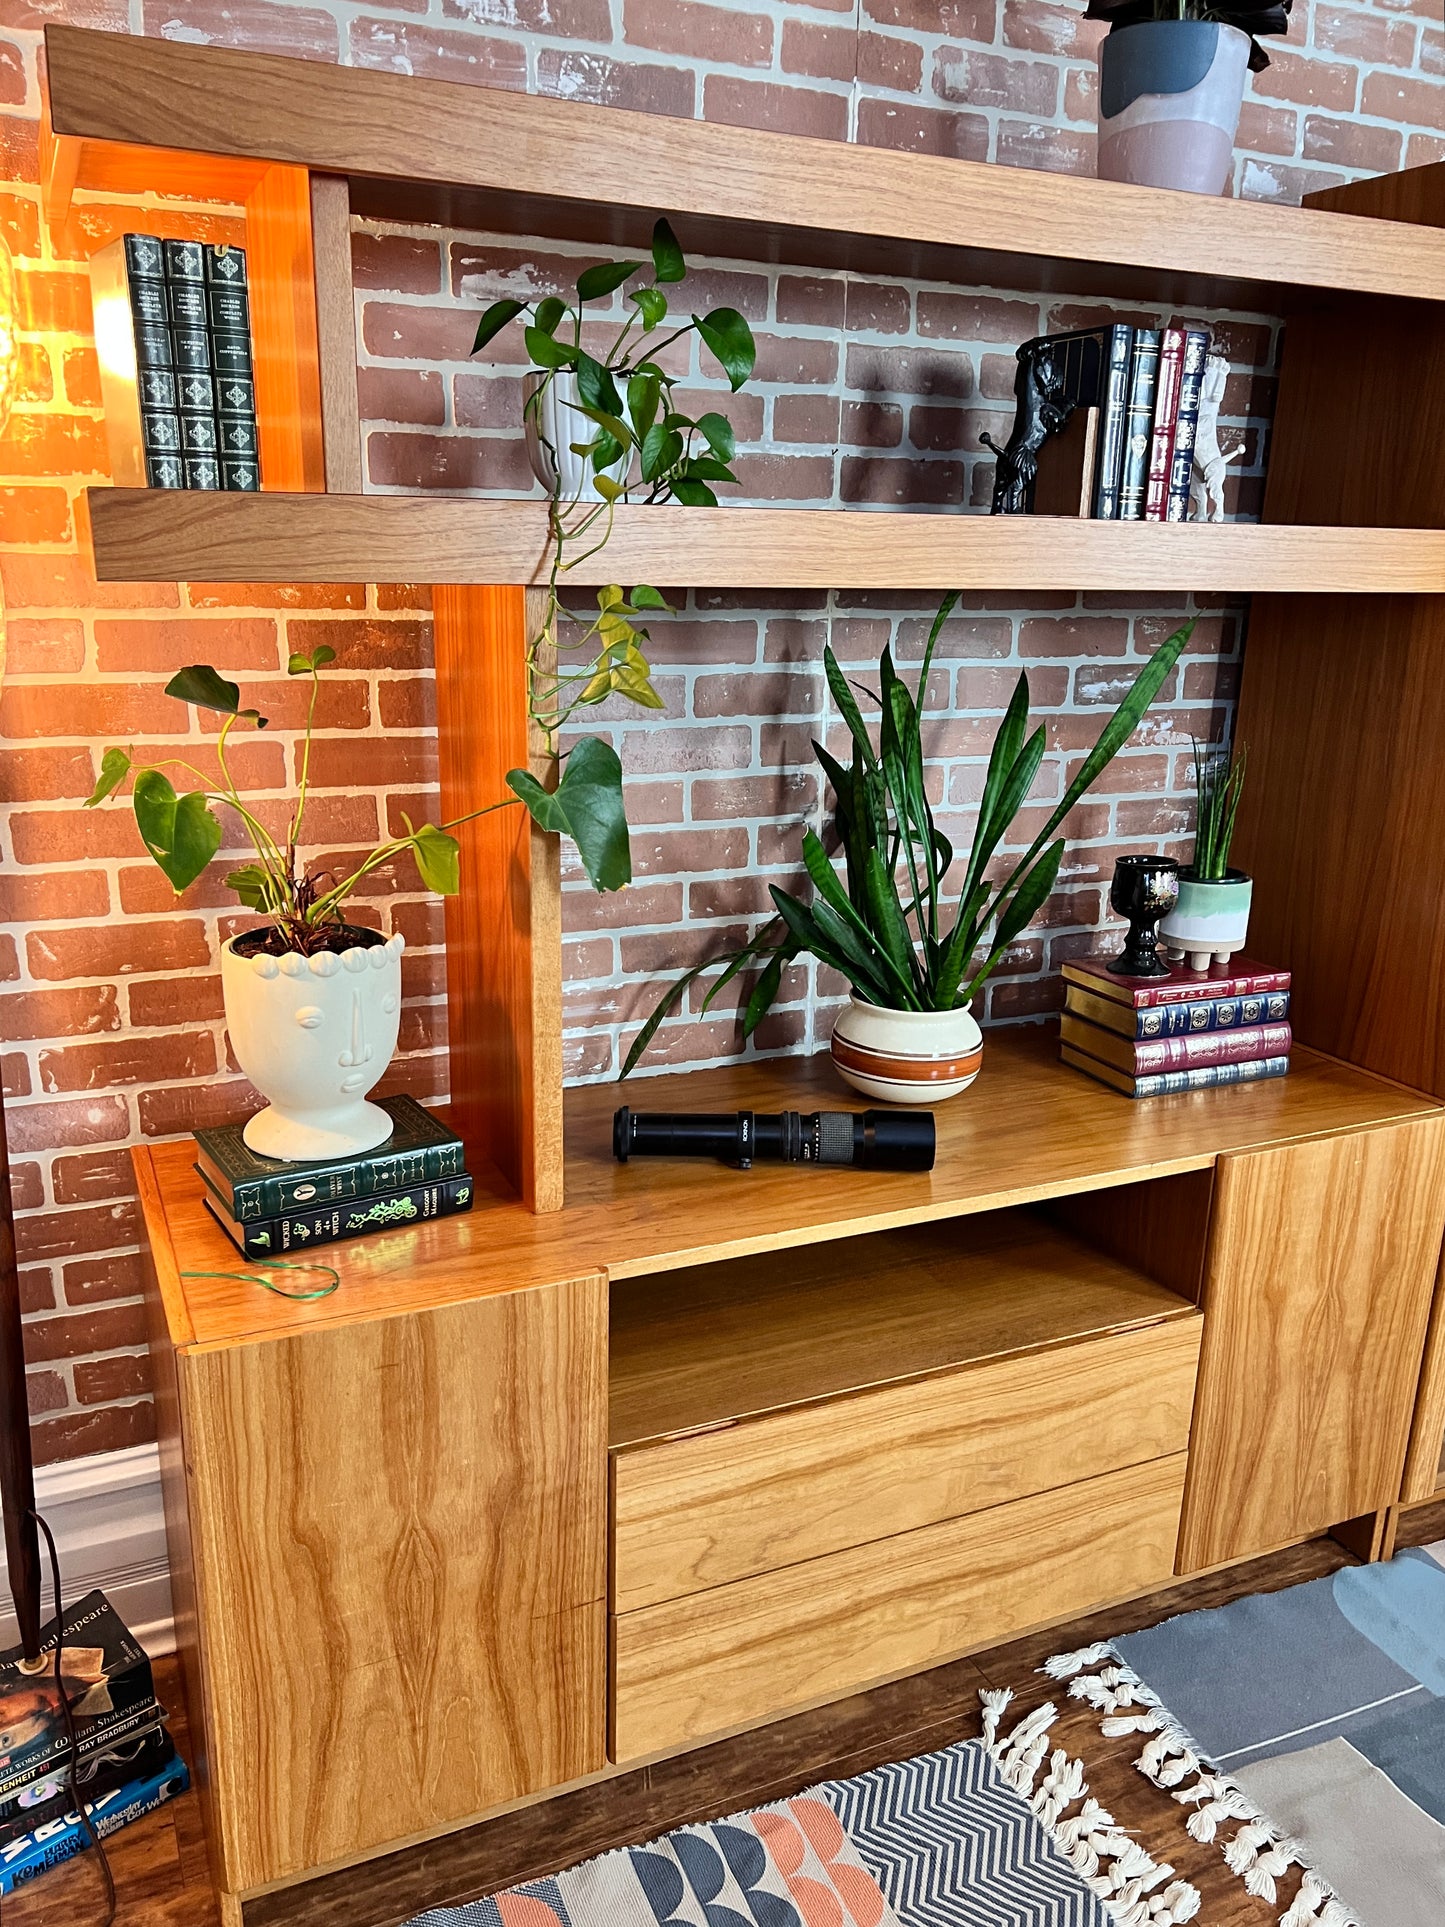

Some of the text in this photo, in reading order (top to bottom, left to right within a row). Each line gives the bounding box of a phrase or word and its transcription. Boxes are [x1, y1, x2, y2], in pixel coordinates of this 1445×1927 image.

[282, 1220, 290, 1249] WICKED
[314, 1219, 322, 1236] SON
[332, 1211, 340, 1236] WITCH
[40, 1603, 109, 1654] haespeare
[16, 1753, 41, 1770] WORKS
[54, 1726, 96, 1750] Wiliam
[97, 1695, 153, 1728] Shakespeare
[38, 1762, 51, 1773] 451
[79, 1739, 96, 1753] RAY
[96, 1717, 140, 1744] BRADBURY
[43, 1832, 82, 1859] HARRY
